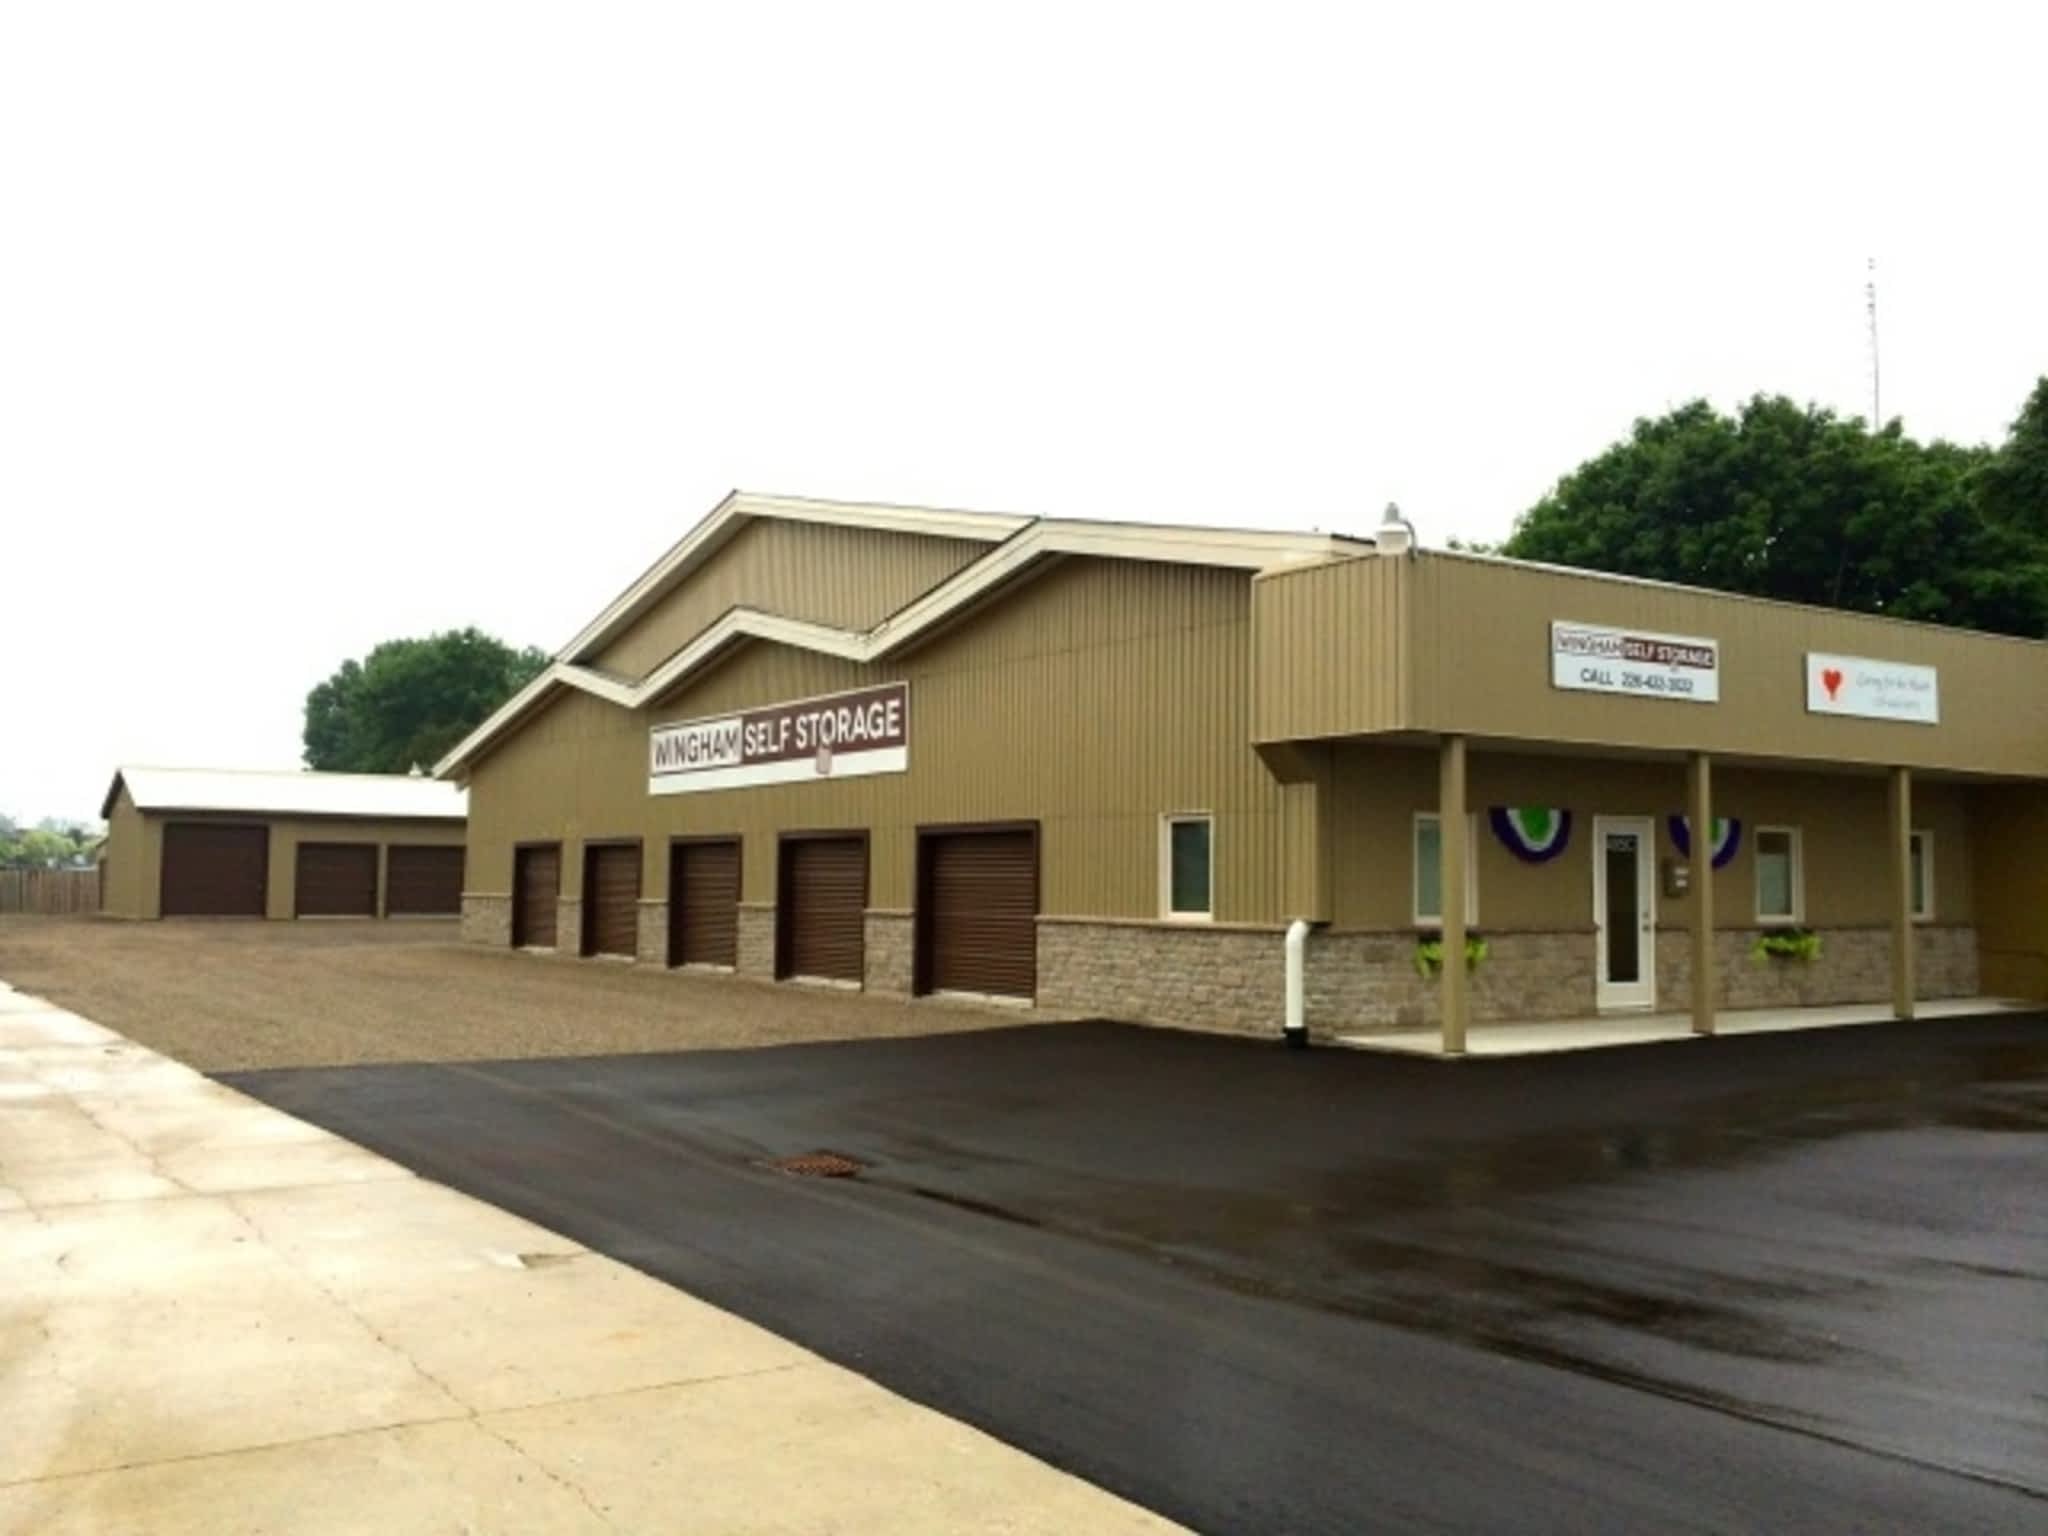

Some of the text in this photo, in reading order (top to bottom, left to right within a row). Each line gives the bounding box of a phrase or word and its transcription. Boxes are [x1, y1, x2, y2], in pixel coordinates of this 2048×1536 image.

[1580, 668, 1614, 686] CALL
[654, 699, 901, 767] WINGHAM SELF STORAGE
